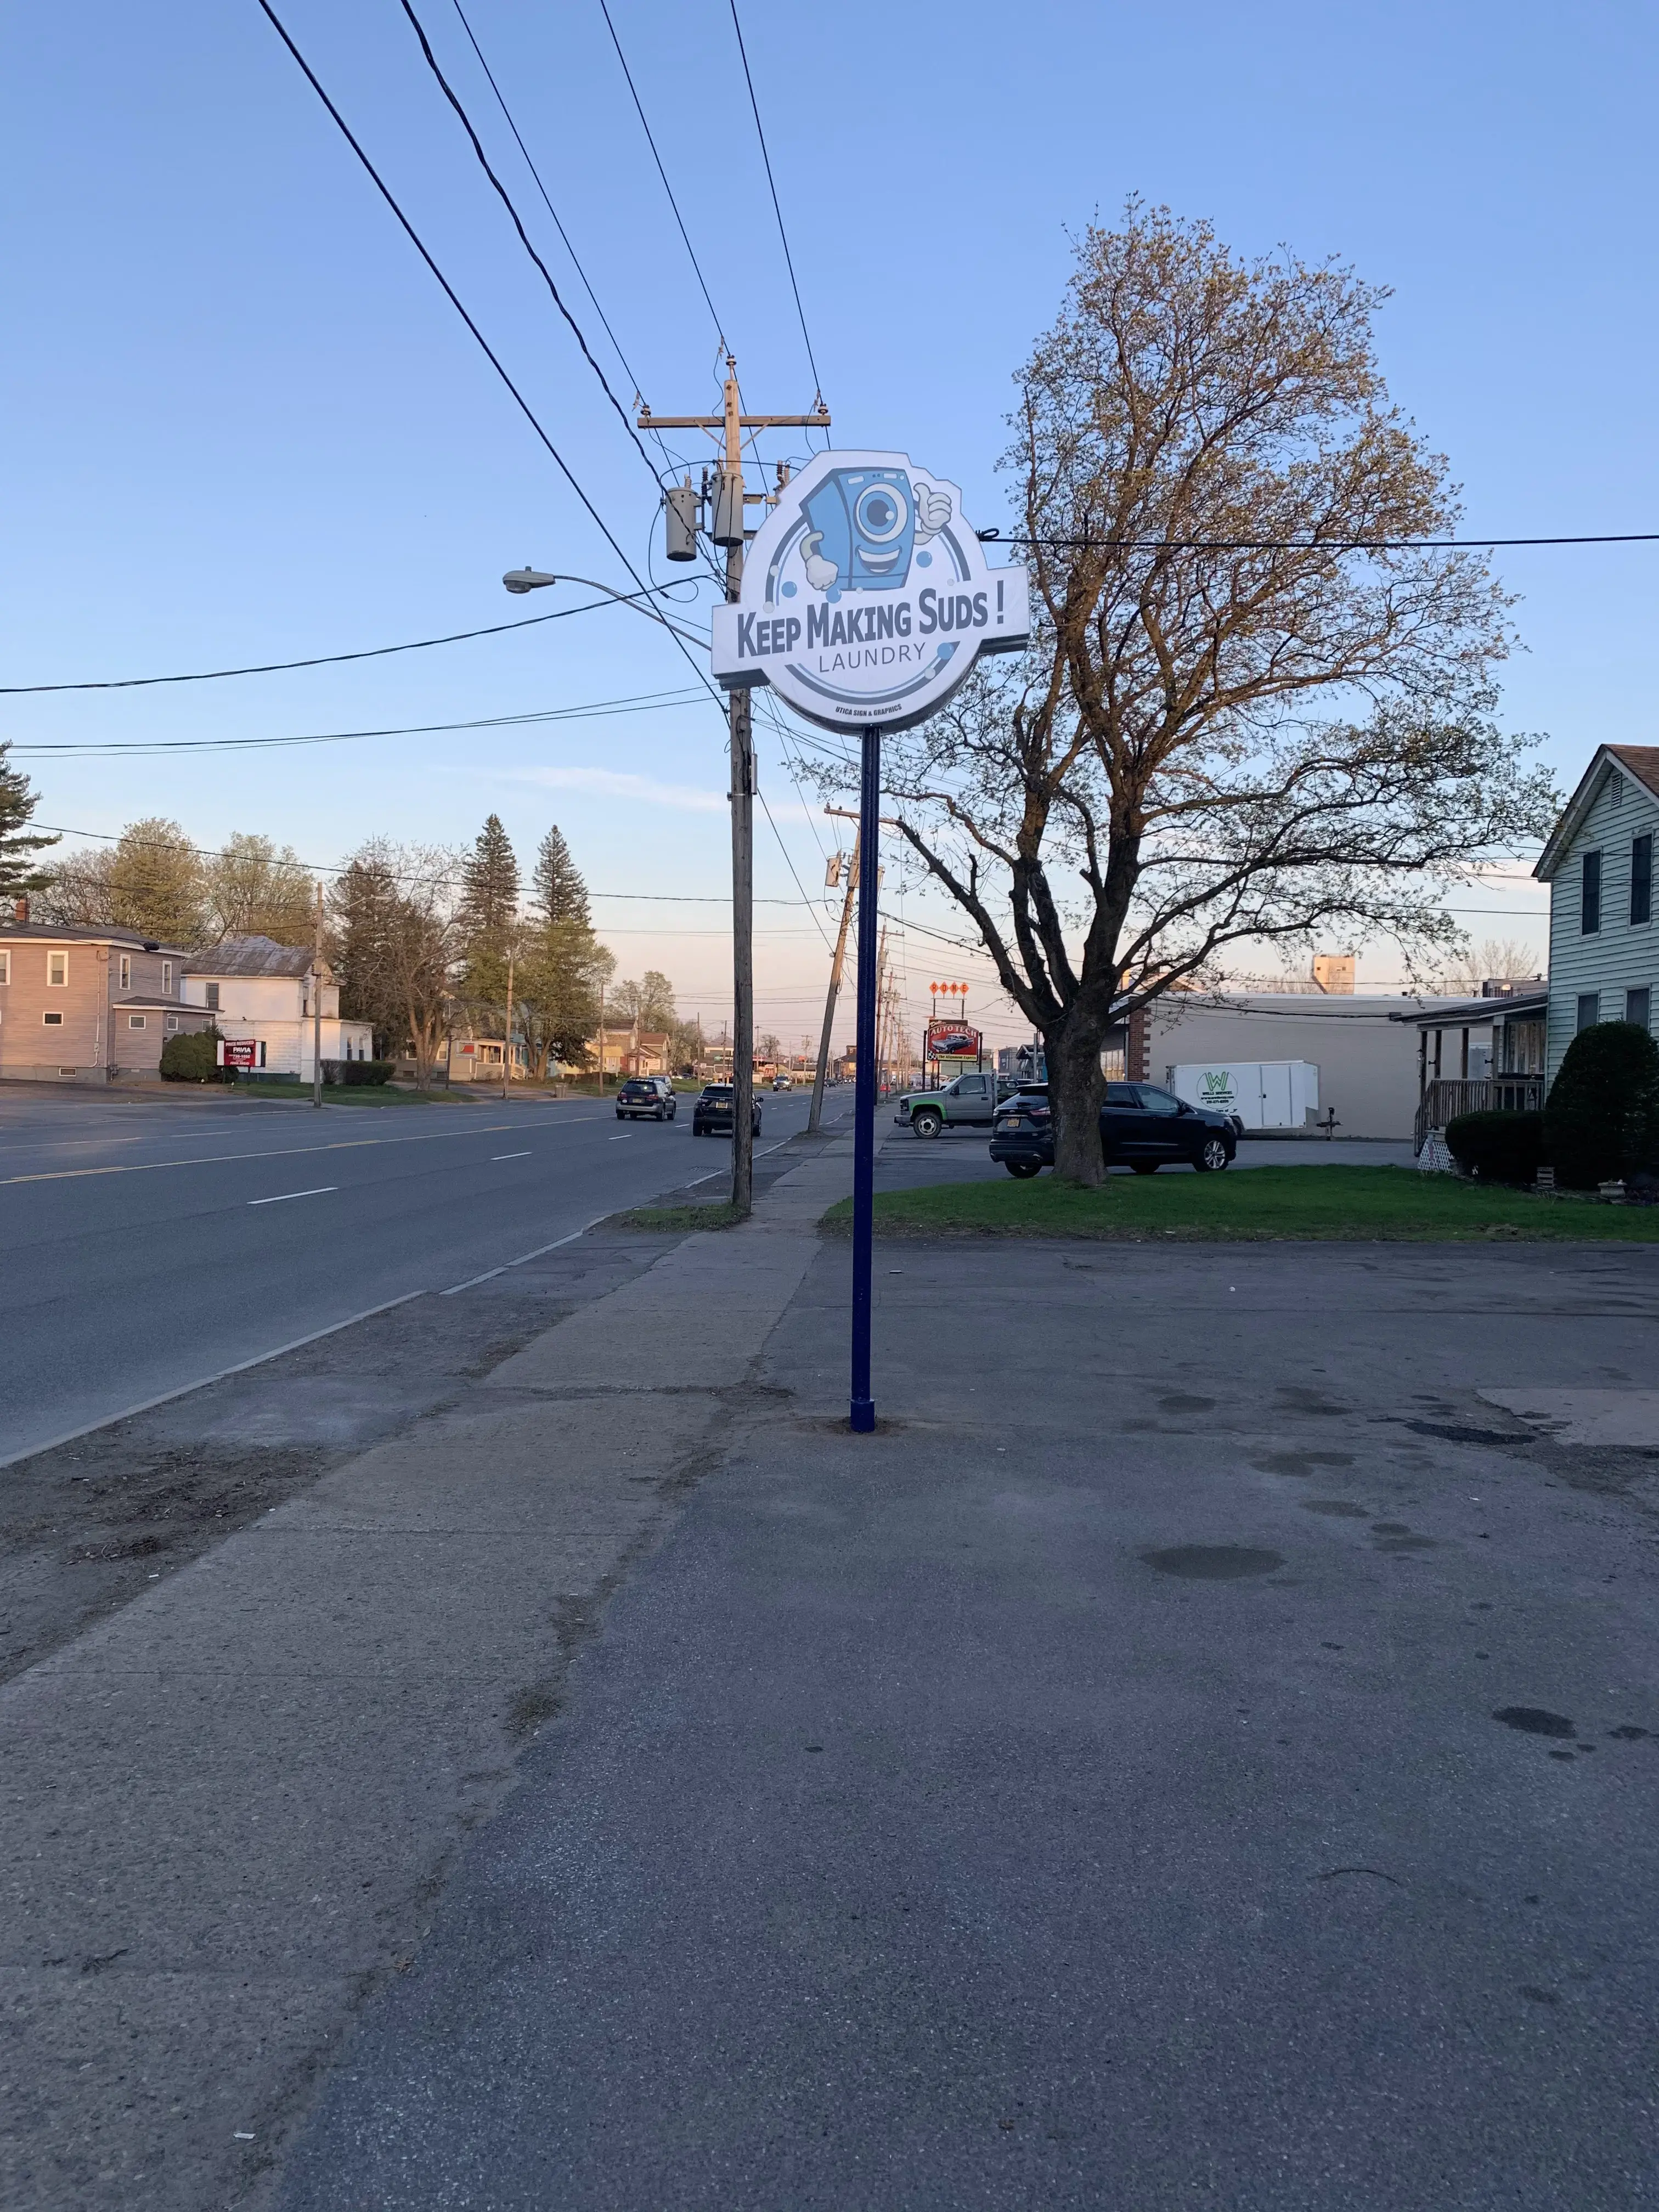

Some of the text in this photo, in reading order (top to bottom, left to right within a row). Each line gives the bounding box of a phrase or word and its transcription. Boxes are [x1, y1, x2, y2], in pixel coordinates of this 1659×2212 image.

[819, 642, 926, 673] LAUNDRY
[836, 706, 852, 715] UTICA
[873, 703, 902, 715] GRAPHICS
[930, 1025, 977, 1037] AUTO TECH
